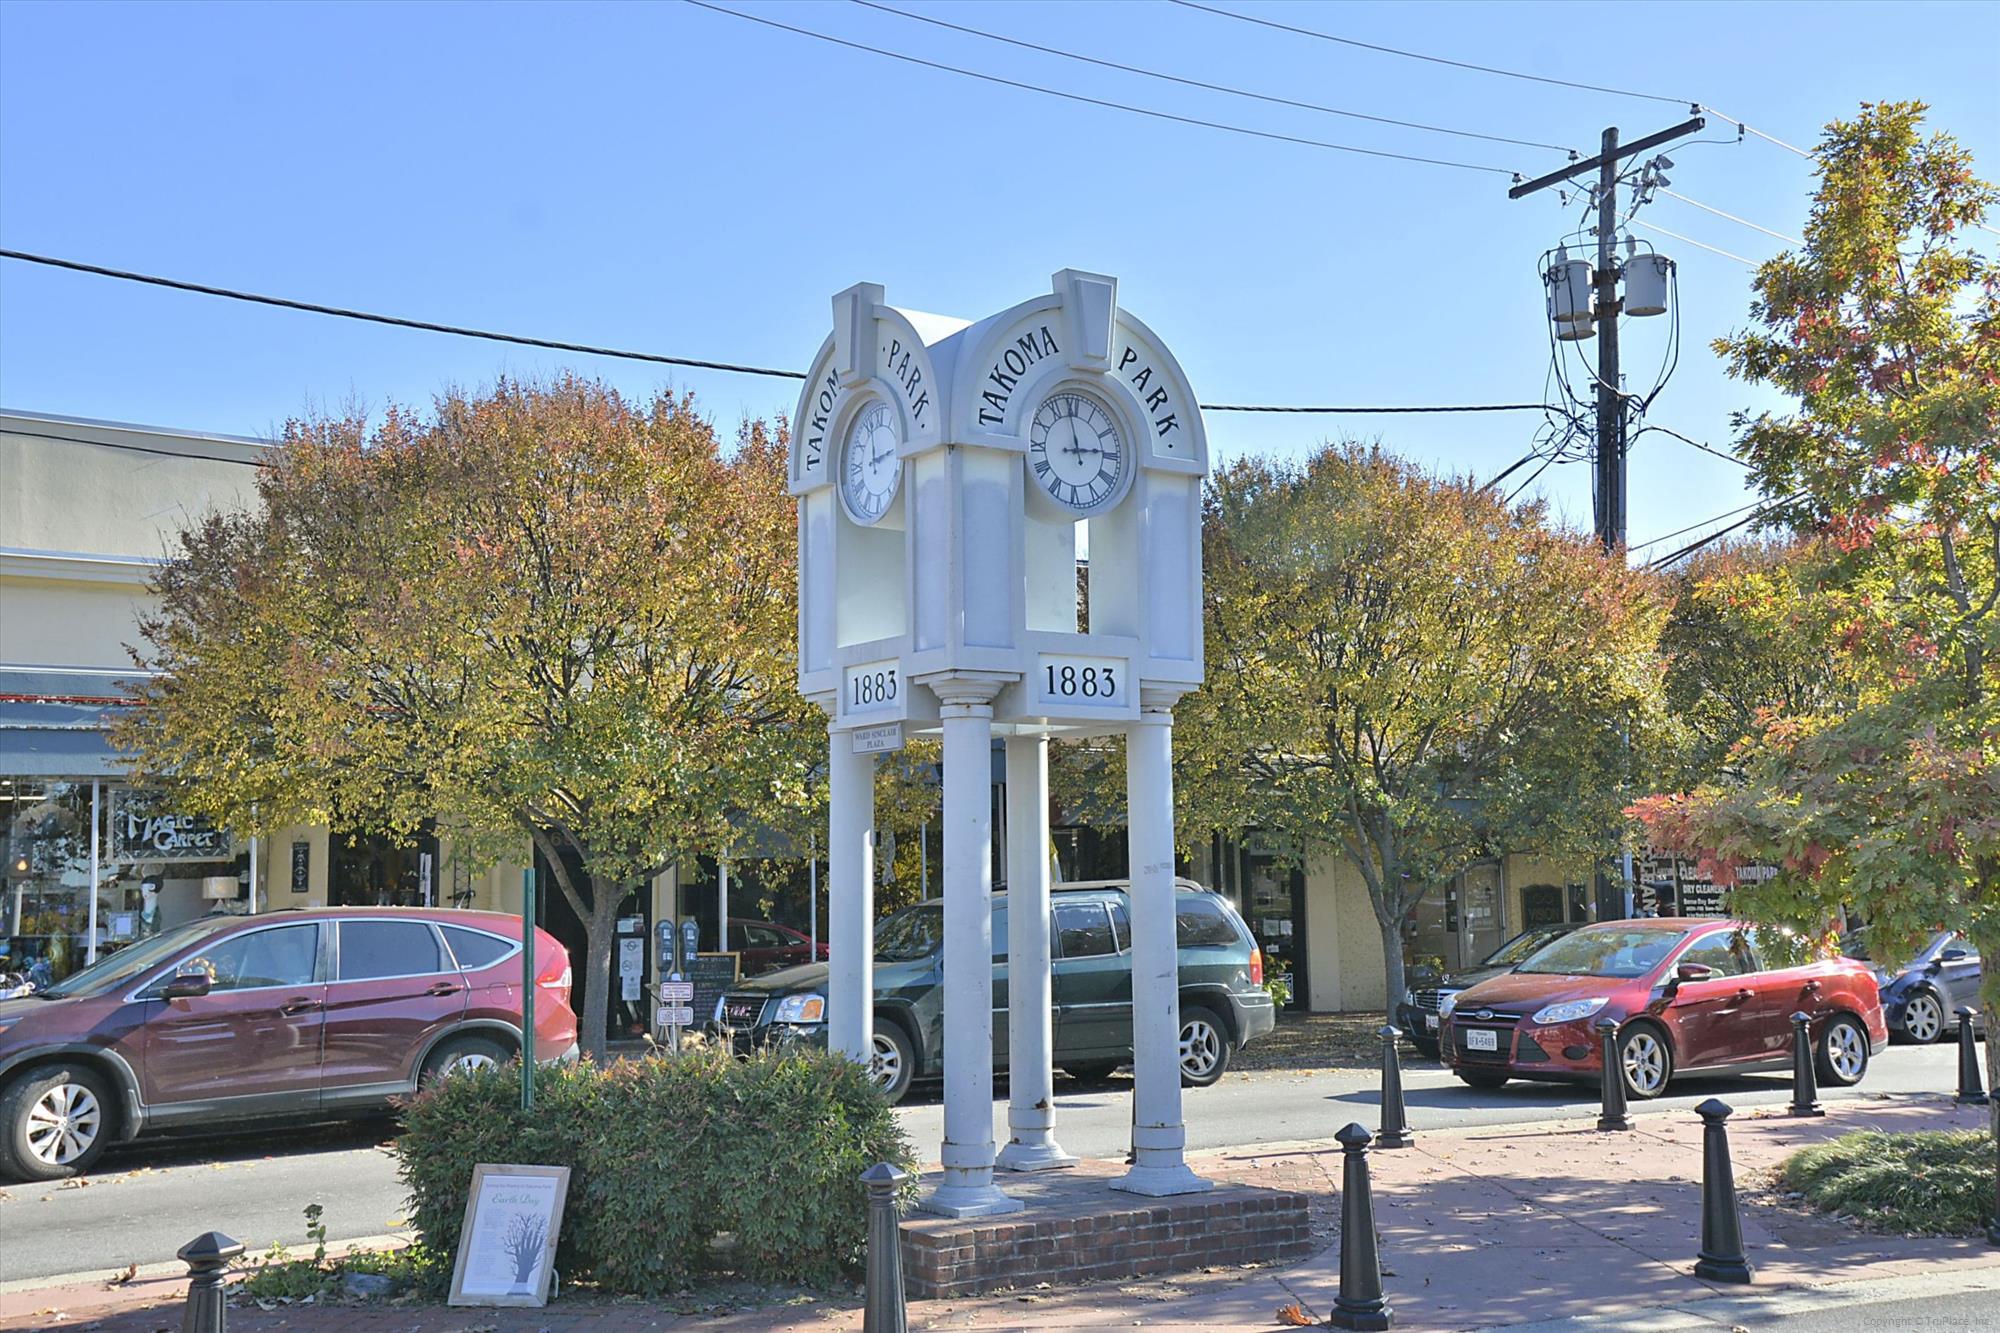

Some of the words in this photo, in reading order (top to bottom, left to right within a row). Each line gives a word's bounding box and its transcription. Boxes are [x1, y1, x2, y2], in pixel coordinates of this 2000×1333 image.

[979, 326, 1059, 426] TAKOMA
[1118, 346, 1180, 437] PARK
[806, 367, 843, 471] TAKOM
[888, 339, 930, 421] PARK
[853, 670, 897, 705] 1883
[1046, 665, 1115, 697] 1883
[1682, 884, 1695, 894] DRY
